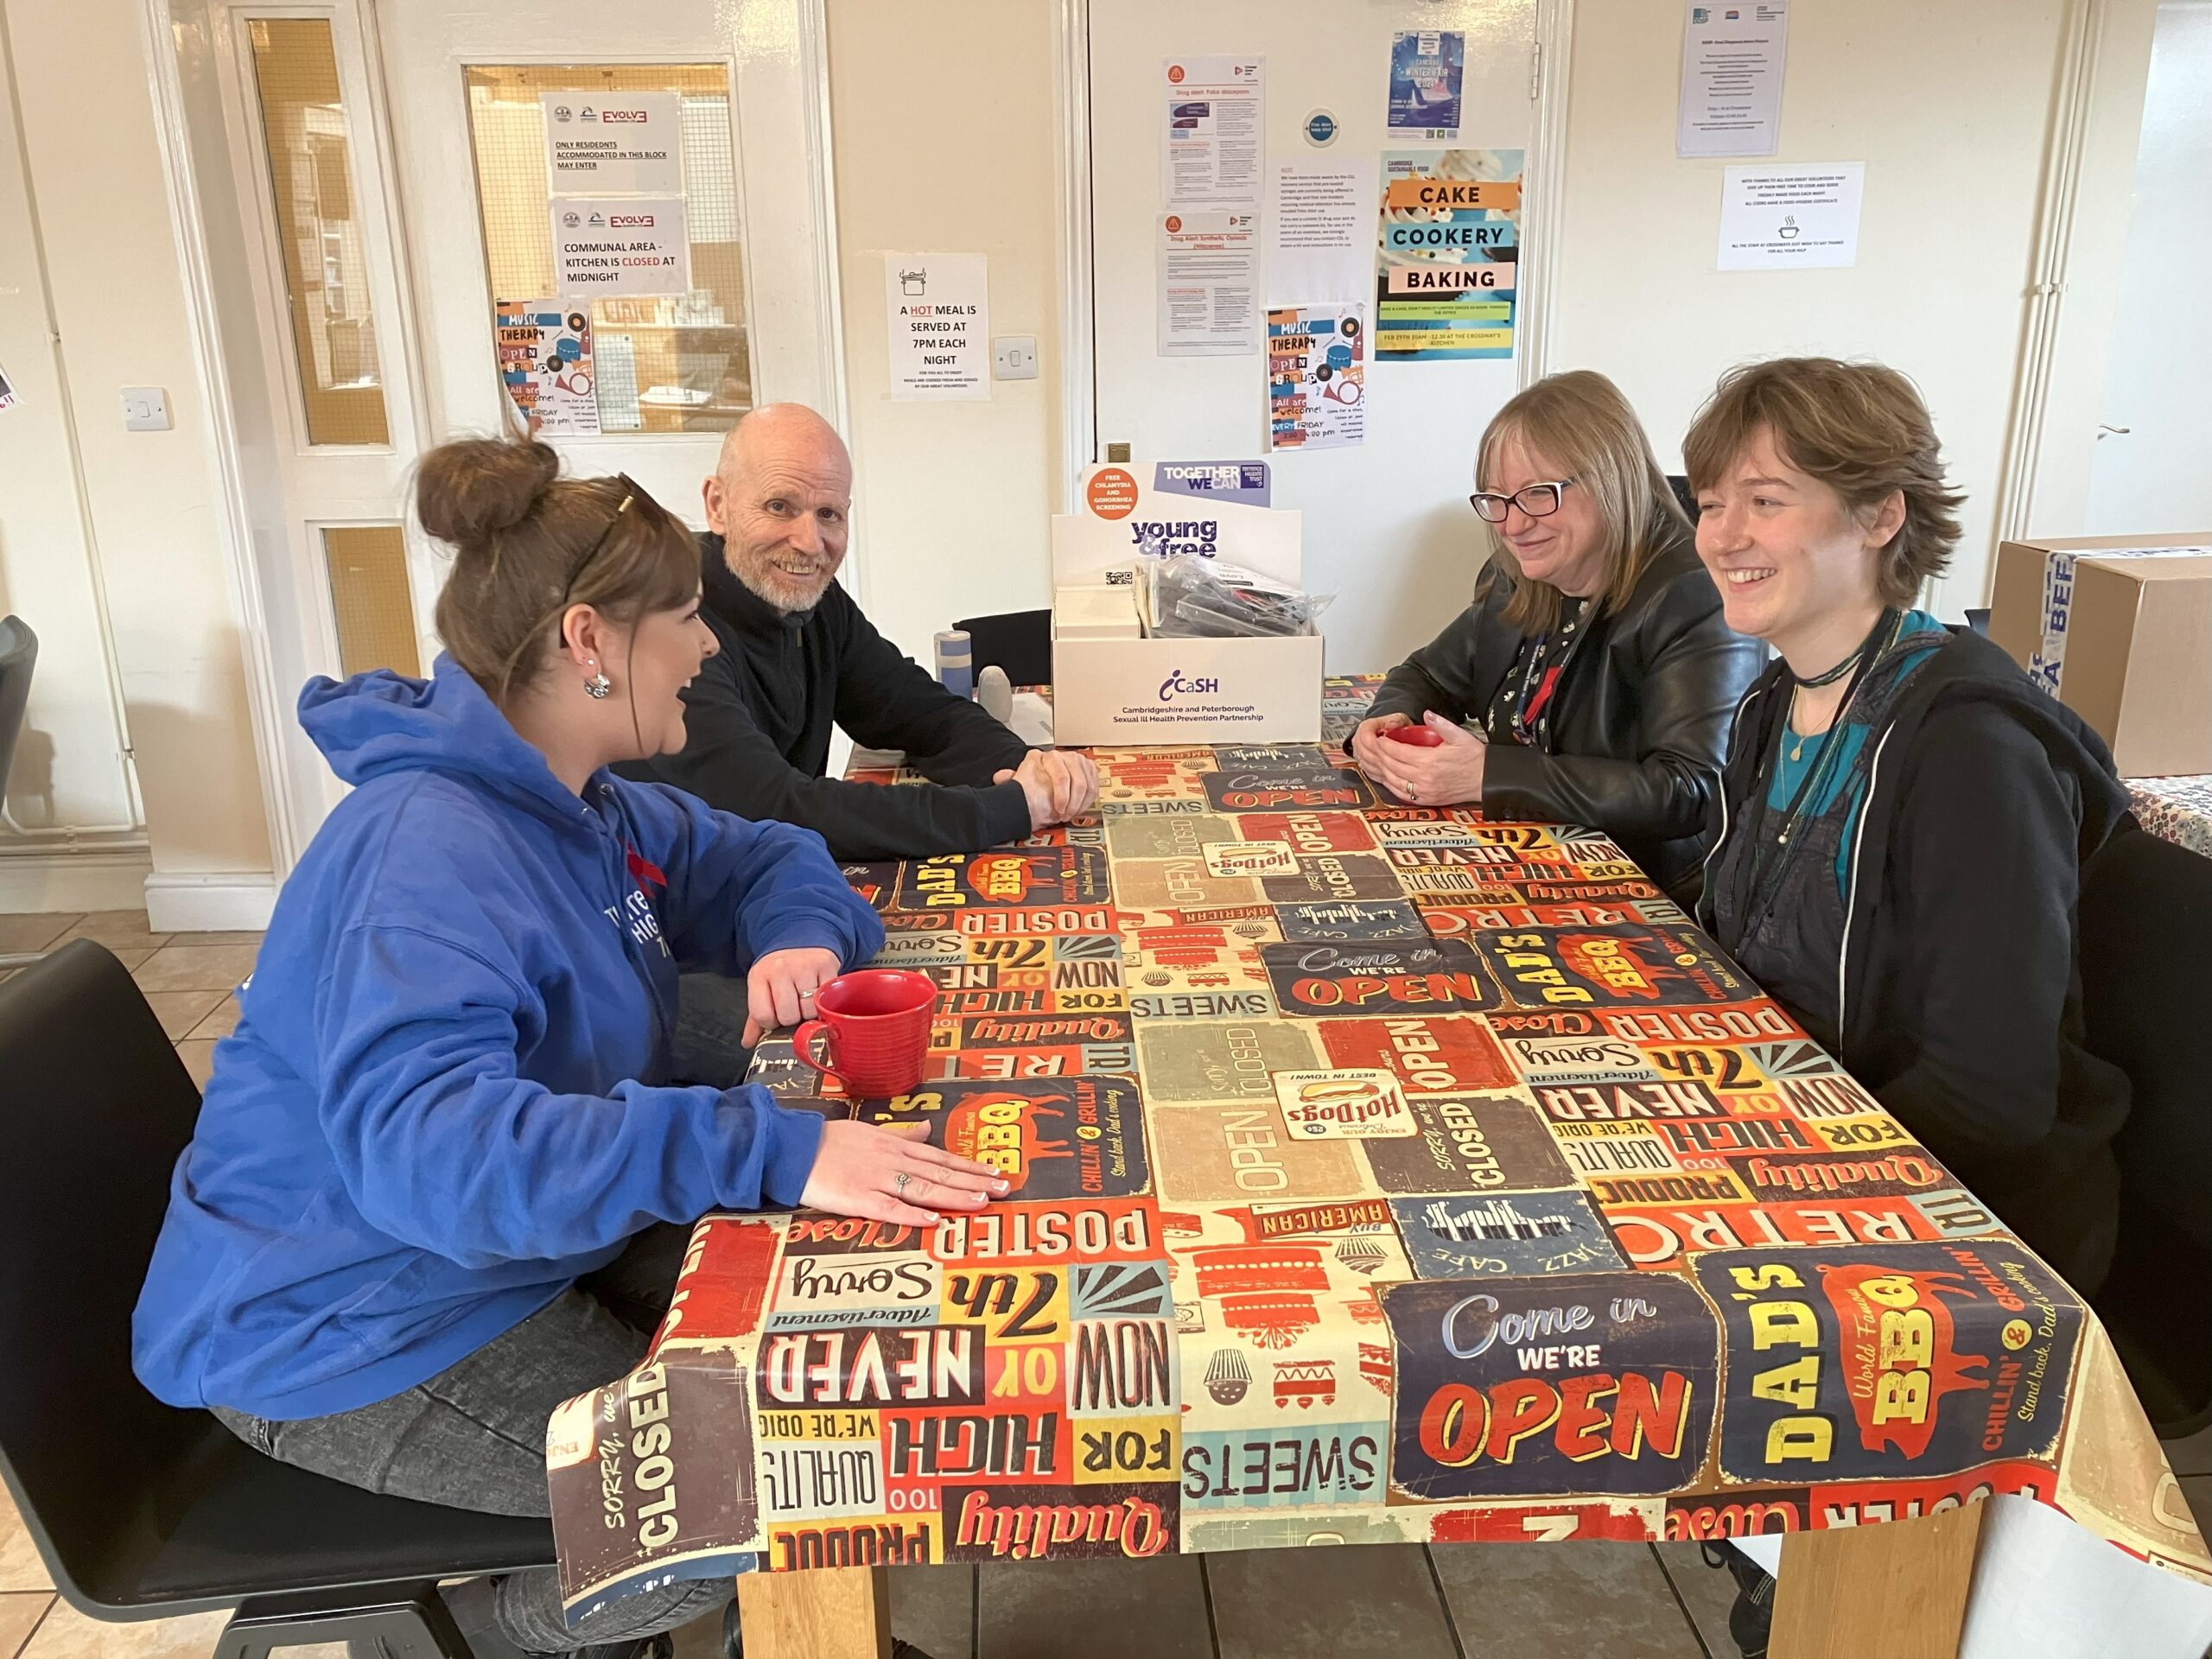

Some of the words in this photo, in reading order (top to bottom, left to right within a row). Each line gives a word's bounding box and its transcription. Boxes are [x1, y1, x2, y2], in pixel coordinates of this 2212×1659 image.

[603, 111, 647, 123] EVOLVE
[1421, 187, 1480, 203] CAKE
[611, 216, 653, 227] EVOLVE
[1394, 228, 1503, 245] COOKERY
[564, 244, 626, 252] COMMUNAL
[566, 258, 607, 267] KITCHEN
[622, 257, 659, 266] CLOSED
[663, 257, 675, 265] AT
[568, 273, 619, 282] MIDNIGHT
[1408, 271, 1495, 288] BAKING
[509, 314, 539, 326] MUSIC
[911, 306, 932, 315] HOT
[936, 306, 964, 315] MEAL
[968, 306, 976, 315] IS
[912, 322, 950, 331] SERVED
[953, 322, 966, 331] AT
[1281, 321, 1312, 334] MUSIC
[500, 328, 544, 340] THERAPY
[939, 339, 966, 347] EACH
[1272, 337, 1316, 351] THERAPY
[500, 347, 537, 359] OPEN
[507, 363, 548, 374] GROUP
[1271, 358, 1306, 371] OPEN
[1276, 373, 1317, 385] GROUP
[1164, 466, 1240, 479] TOGETHER
[1131, 520, 1217, 543] young
[1146, 750, 1211, 760] AMERICAN
[1102, 801, 1203, 814] SWEETS
[1222, 789, 1361, 807] OPEN
[917, 854, 965, 906] DAD'S
[988, 857, 1027, 895] BBQ
[962, 911, 1108, 933] POSTER
[1185, 907, 1269, 923] AMERICAN
[1055, 961, 1119, 988] NOW
[1297, 948, 1401, 972] Come
[1497, 934, 1594, 1003] DAD'S
[1580, 938, 1649, 989] BBQ
[1130, 995, 1268, 1018] SWEETS
[1291, 972, 1478, 1007] OPEN
[1610, 1005, 1789, 1040] POSTER
[1226, 1027, 1272, 1091] CLOSED
[1383, 1020, 1458, 1089] OPEN
[1516, 1039, 1641, 1067] Sorry
[1652, 1046, 1764, 1090] 7th
[1287, 1086, 1401, 1122] HotDogs
[1542, 1083, 1718, 1119] NEVER
[1784, 1077, 1878, 1118] NOW
[1438, 1102, 1506, 1185] CLOSED
[1662, 1119, 1813, 1153] HIGH
[1820, 1119, 1909, 1146] FOR
[1219, 1110, 1289, 1192] OPEN
[1748, 1154, 1945, 1192] Quality
[934, 1208, 1151, 1260] POSTER
[1262, 1203, 1383, 1233] AMERICAN
[1431, 1247, 1508, 1274] CAFE
[1537, 1243, 1601, 1272] JAZZ
[793, 1258, 933, 1299] Sorry
[1942, 1247, 2024, 1311] GRILLIN'
[950, 1271, 1058, 1338] 7th
[1847, 1287, 1878, 1339] Famous
[1441, 1294, 1595, 1359] Come
[1609, 1296, 1657, 1322] in
[766, 1329, 972, 1404] NEVER
[1072, 1321, 1171, 1410] NOW
[1516, 1344, 1600, 1371] WE'RE
[1728, 1263, 1833, 1464] DAD'S
[1859, 1274, 1936, 1425] BBQ
[1853, 1344, 1876, 1399] World
[1982, 1356, 2022, 1451] CHILLIN'
[2018, 1381, 2037, 1421] Stand
[1419, 1370, 1693, 1467] OPEN
[627, 1361, 679, 1548] CLOSED
[890, 1411, 1058, 1475] HIGH
[1081, 1428, 1172, 1470] FOR
[1182, 1435, 1377, 1499] SWEETS
[955, 1490, 1170, 1556] Quality
